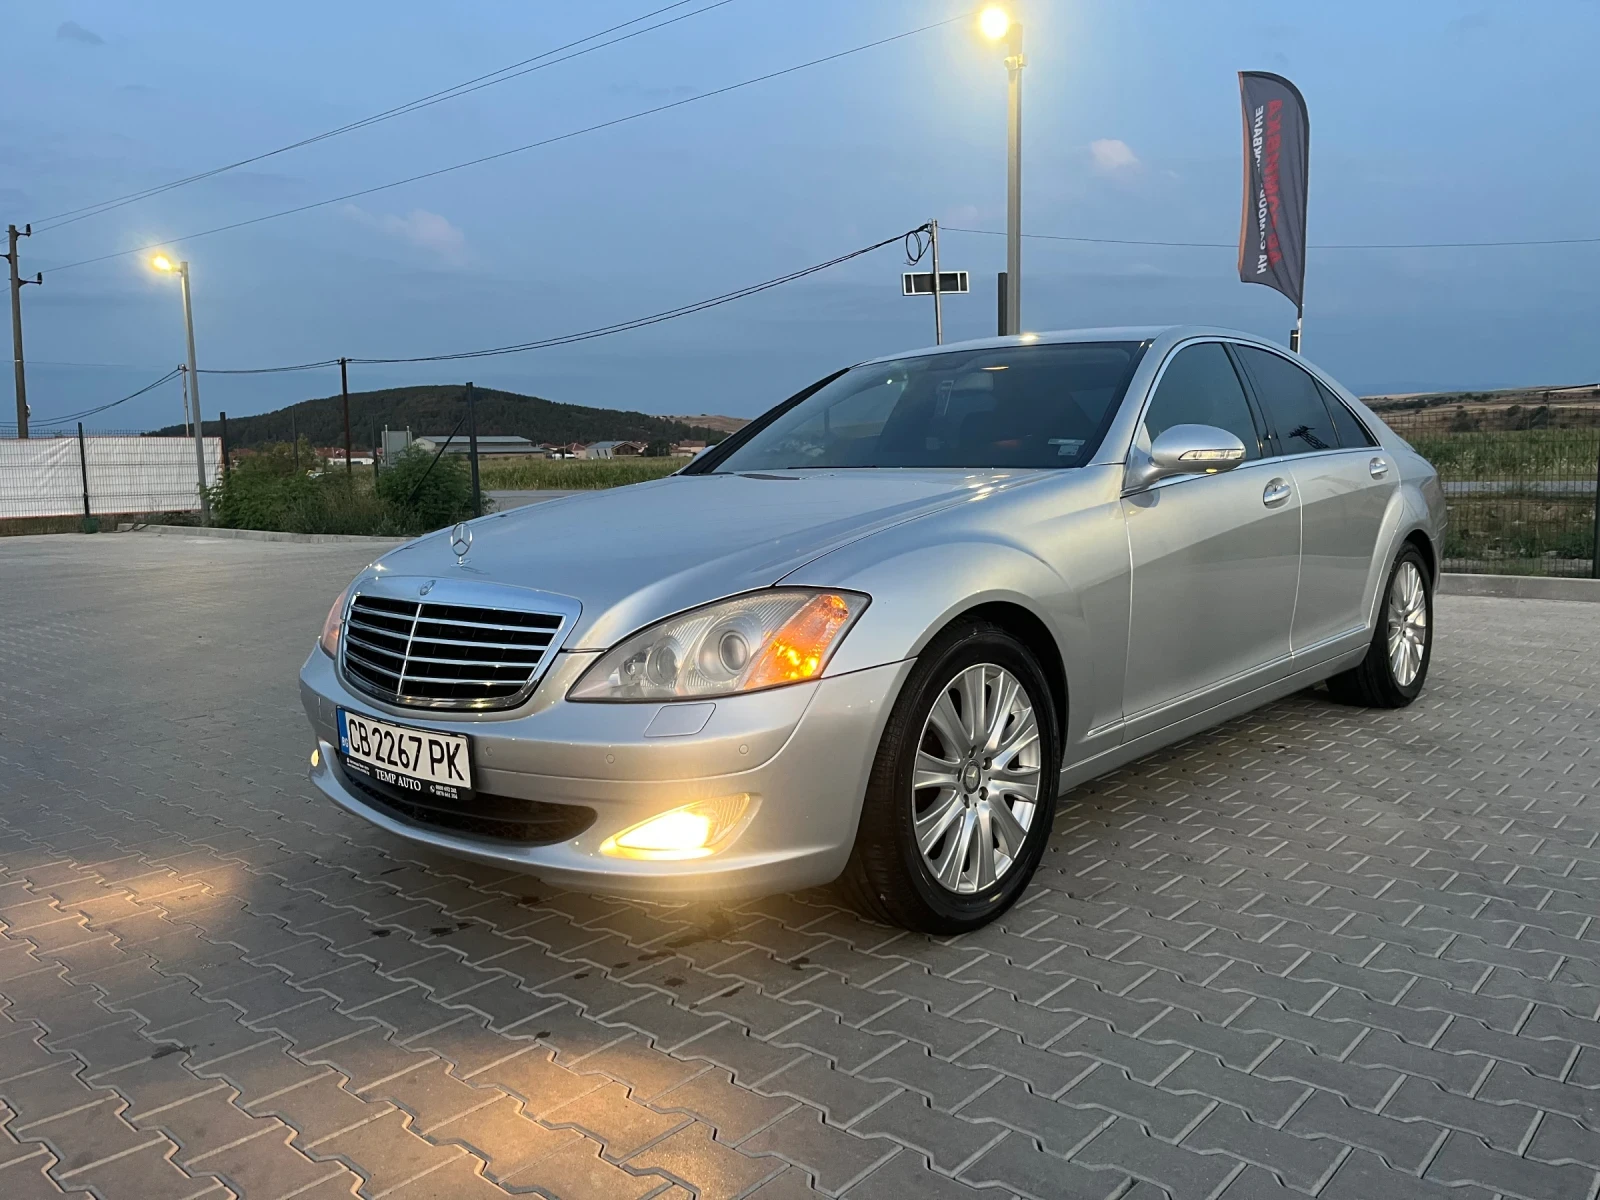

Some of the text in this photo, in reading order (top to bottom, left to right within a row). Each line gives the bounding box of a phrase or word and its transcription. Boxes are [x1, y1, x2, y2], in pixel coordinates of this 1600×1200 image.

[341, 736, 349, 748] BG
[348, 718, 464, 781] CB 2267 PK
[375, 768, 397, 784] TEMP
[398, 775, 421, 791] AUTO
